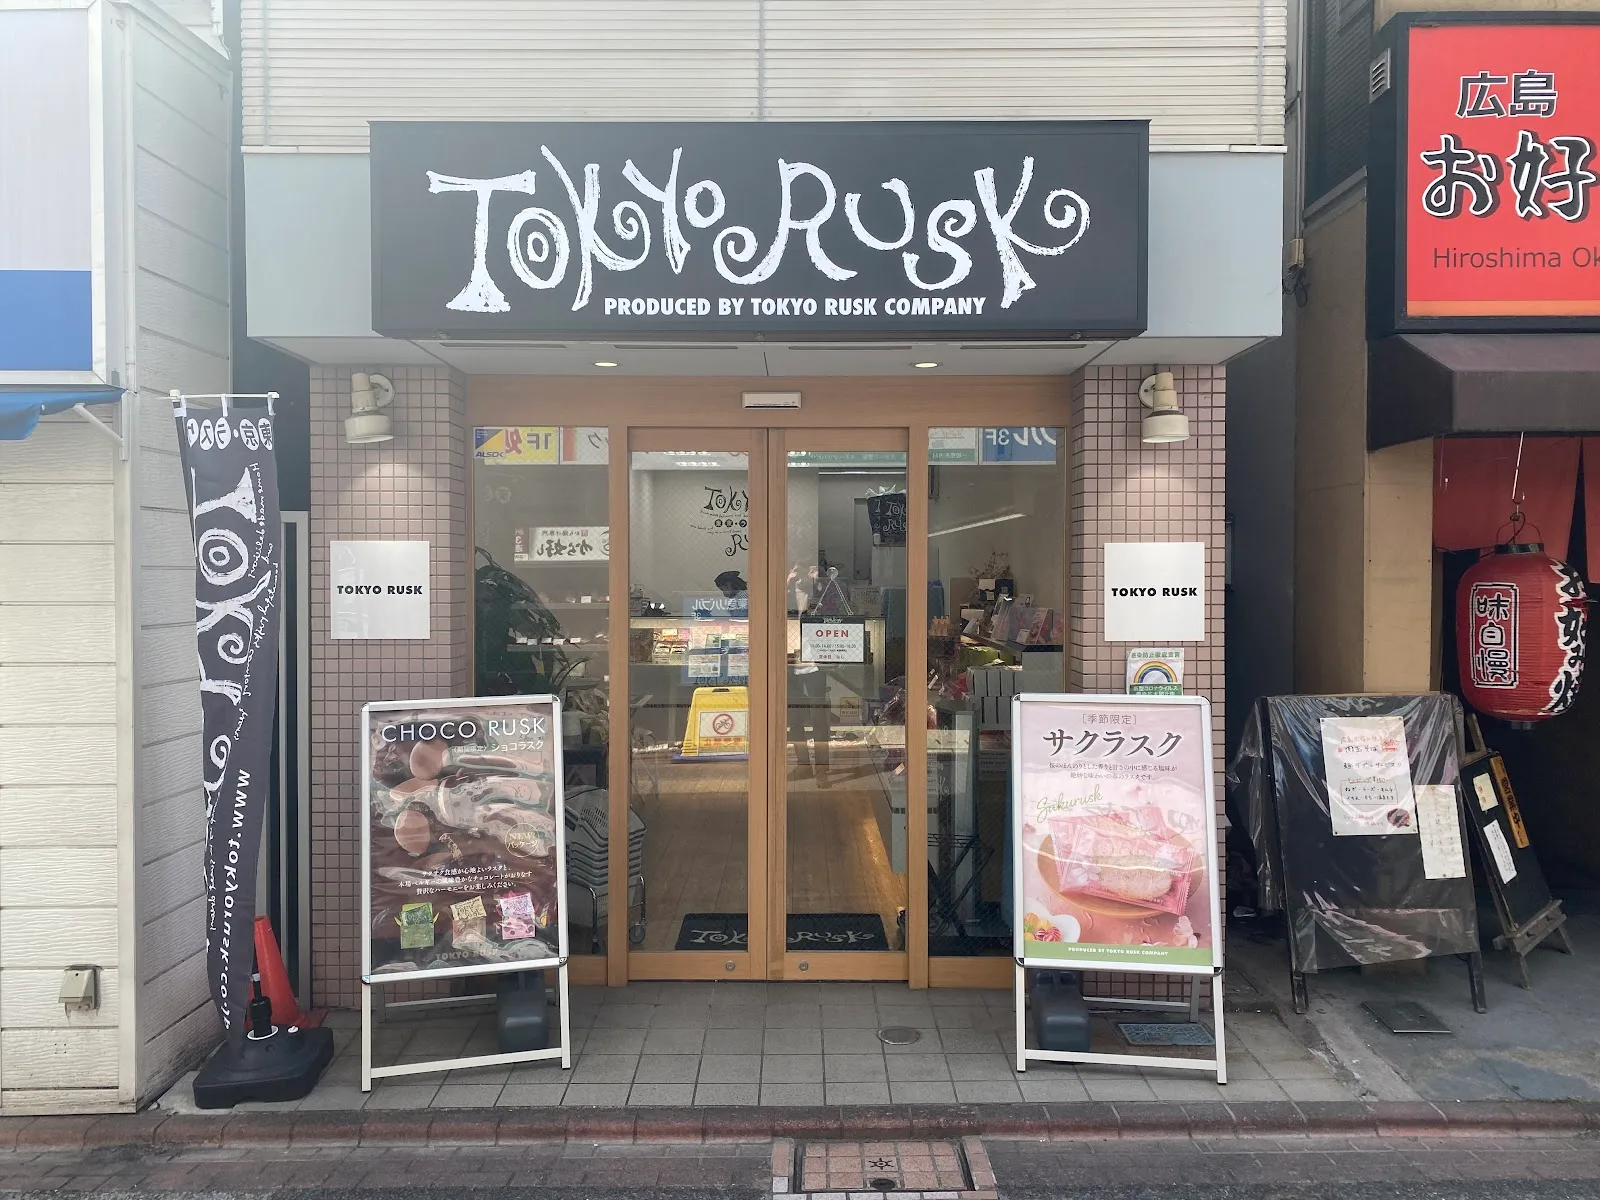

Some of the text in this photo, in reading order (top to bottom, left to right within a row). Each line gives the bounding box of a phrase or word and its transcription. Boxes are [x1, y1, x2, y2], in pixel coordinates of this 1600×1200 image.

[1455, 69, 1558, 118] 広島
[1420, 130, 1597, 220] お好
[427, 145, 1091, 313] TOKYO RUSK
[1433, 247, 1561, 268] Hiroshima
[604, 297, 987, 316] PRODUCED BY TOKYO RUSK COMPANY
[337, 585, 423, 594] TOKYO RUSK
[1111, 587, 1198, 596] TOKYO RUSK
[815, 629, 849, 638] OPEN
[382, 717, 546, 742] CHOCO RUSK
[491, 739, 544, 751] ショコラスク
[1042, 728, 1183, 758] サクラスク
[1036, 784, 1103, 824] Sakurusk
